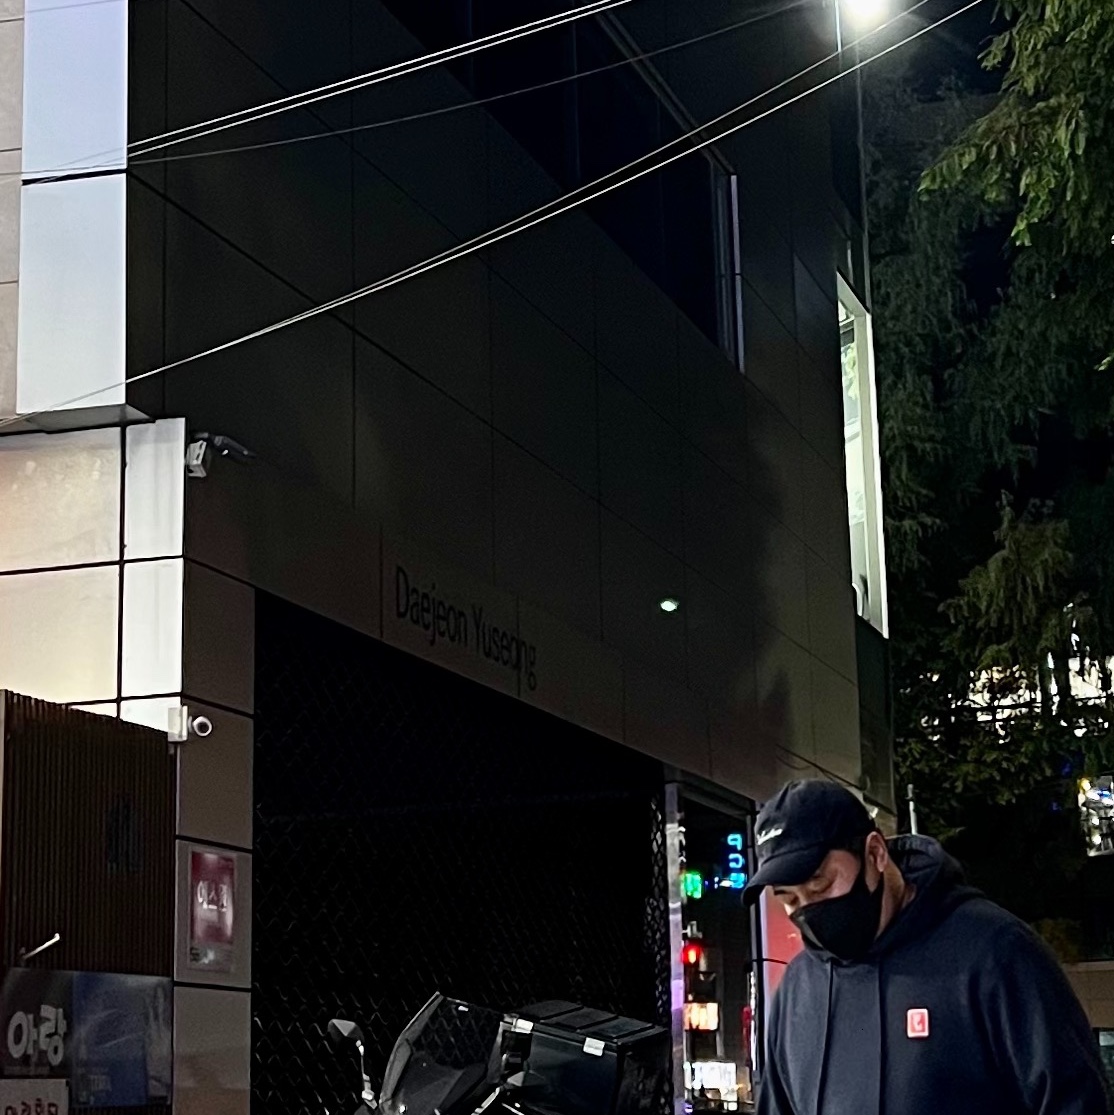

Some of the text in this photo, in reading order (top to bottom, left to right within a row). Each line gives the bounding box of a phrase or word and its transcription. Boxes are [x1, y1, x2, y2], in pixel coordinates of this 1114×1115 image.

[395, 565, 538, 691] Daejeon Yuseong
[7, 1004, 68, 1067] 아랑
